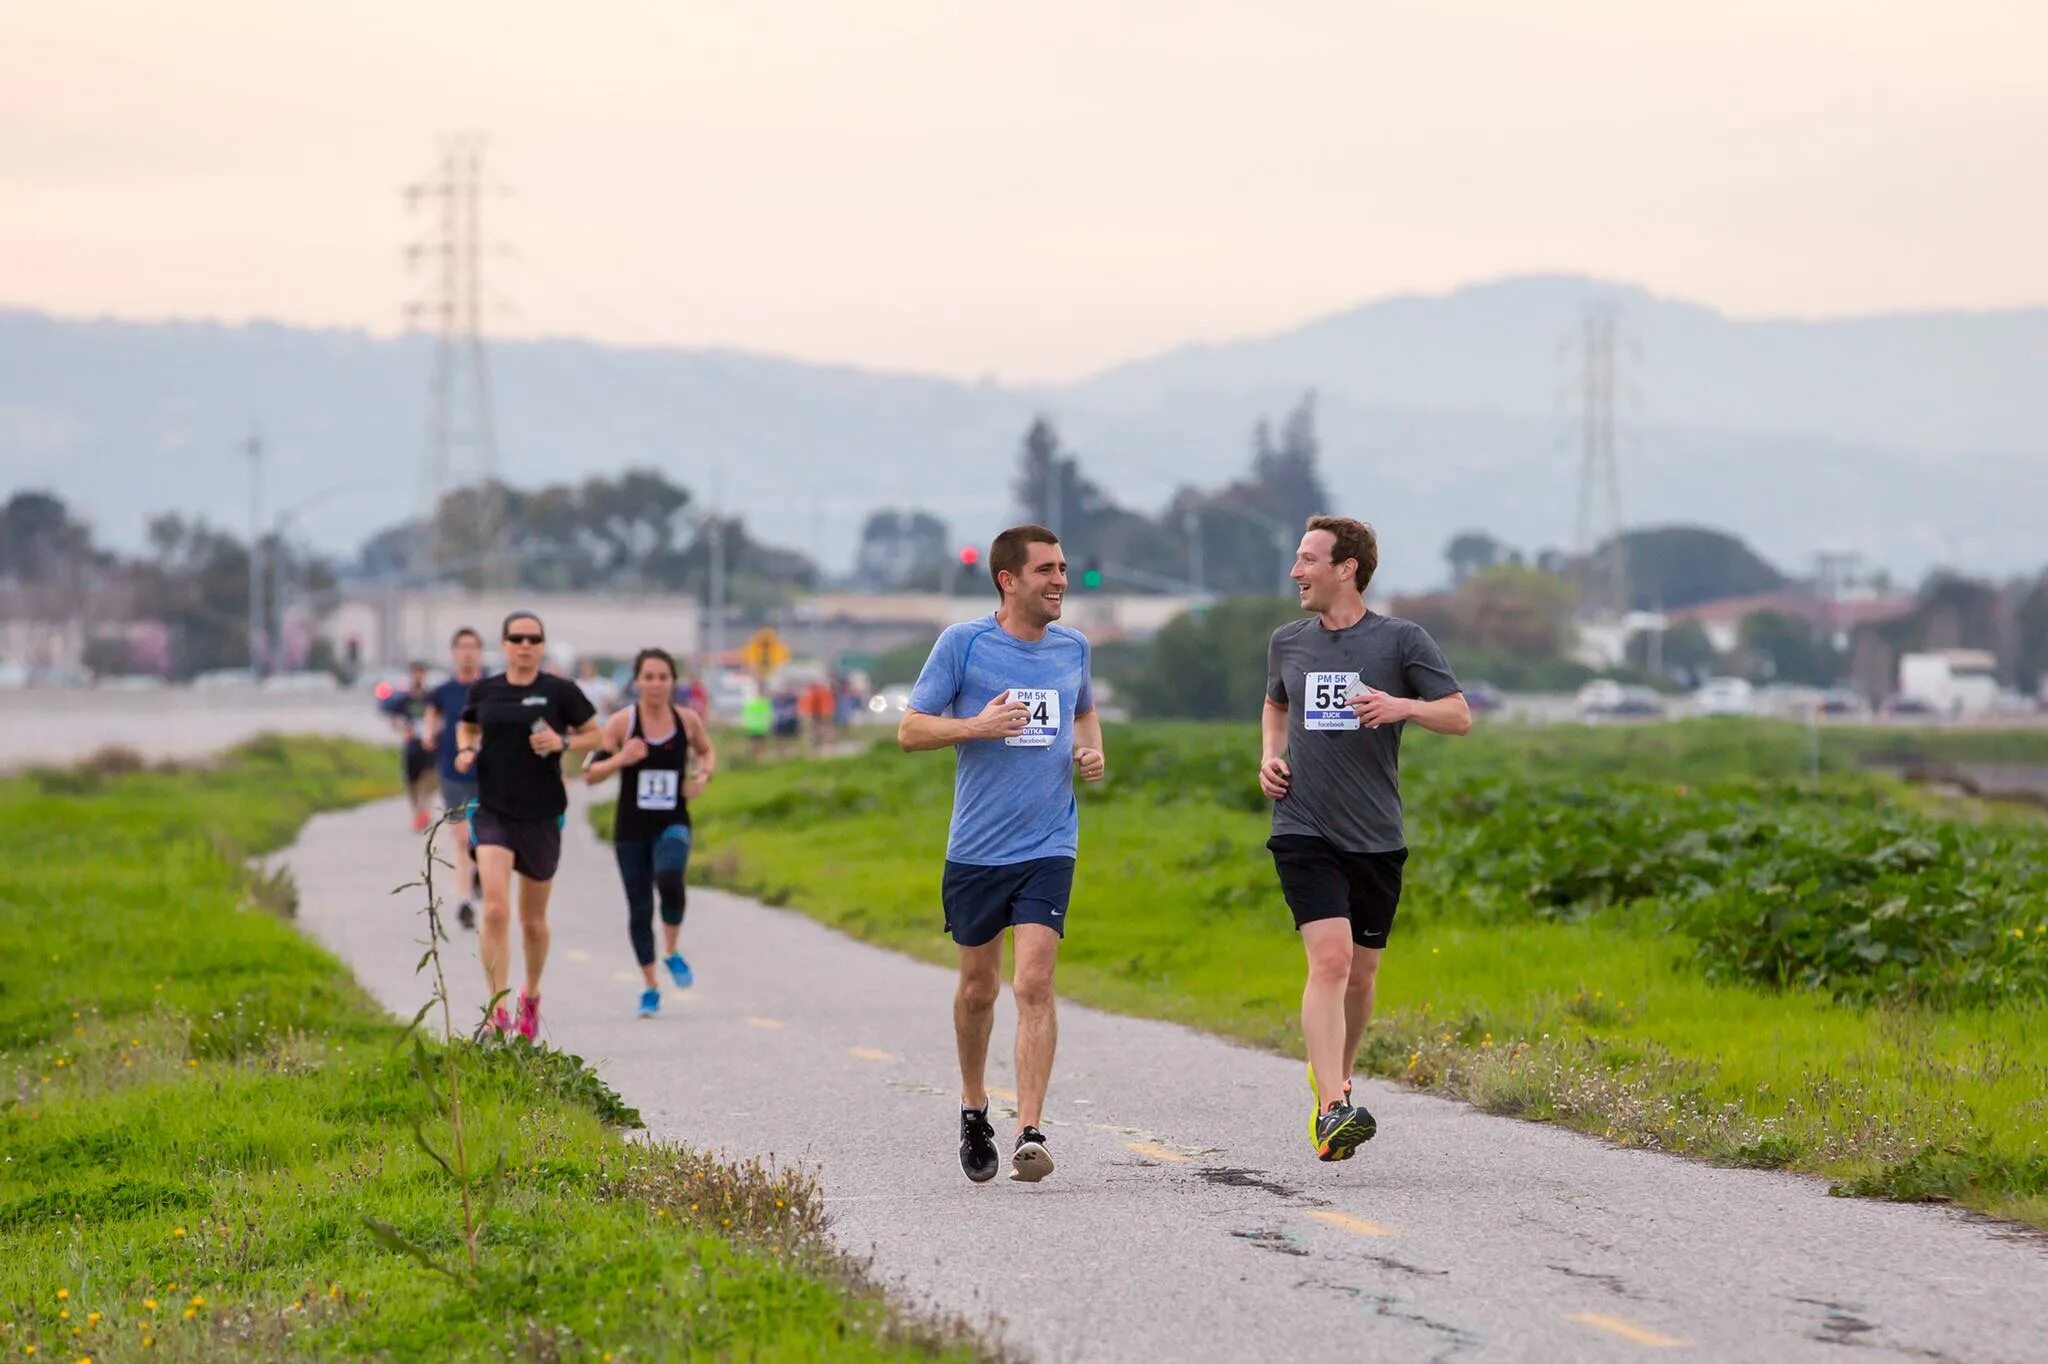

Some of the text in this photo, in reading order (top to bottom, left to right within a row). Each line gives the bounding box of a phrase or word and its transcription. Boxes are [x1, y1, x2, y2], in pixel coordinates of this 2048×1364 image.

[1317, 674, 1347, 683] PM 5K
[1017, 691, 1048, 700] PM 5K
[1315, 685, 1347, 709] 55
[1322, 711, 1341, 719] ZUCK
